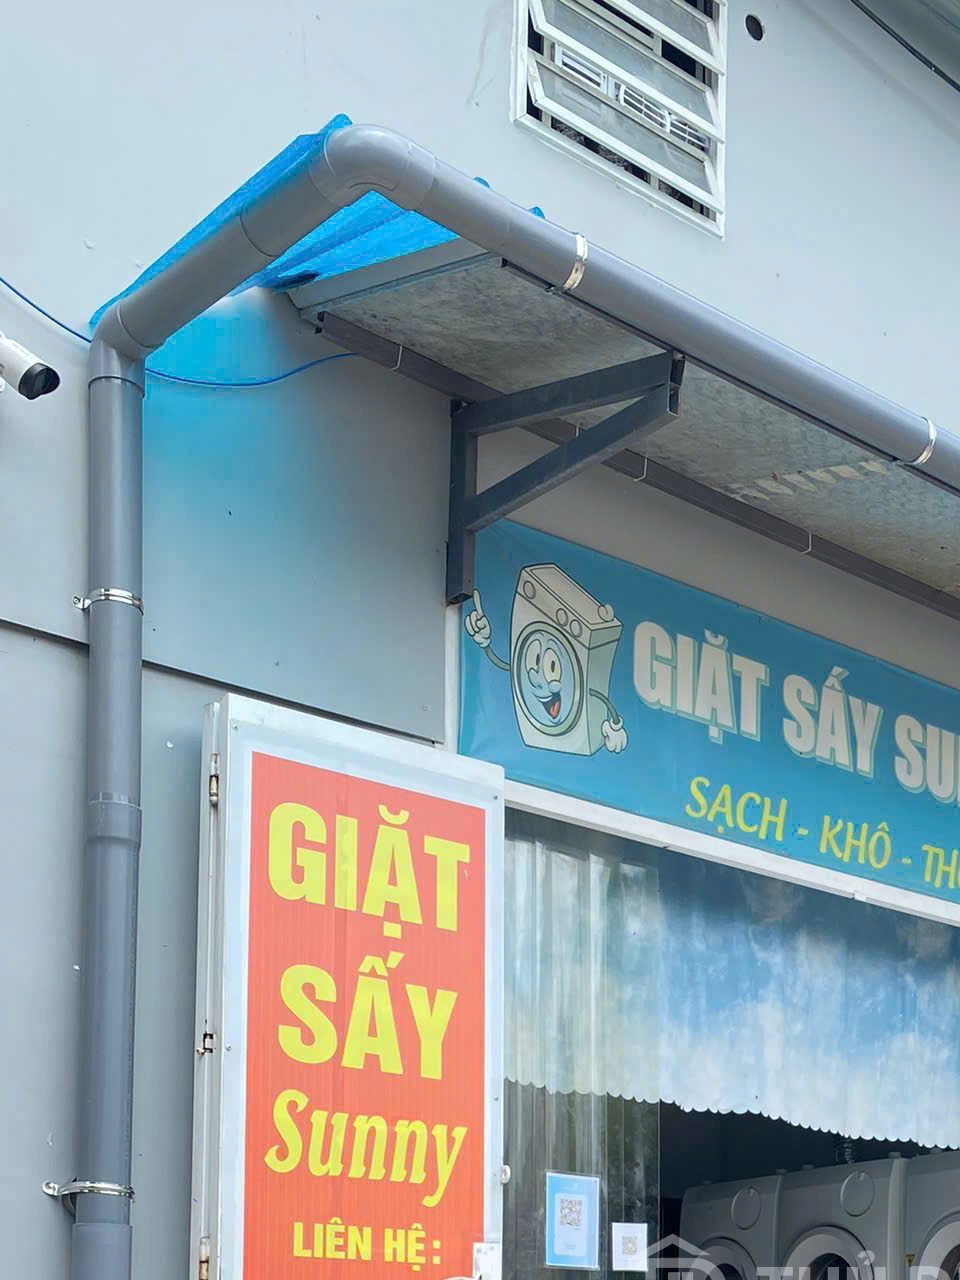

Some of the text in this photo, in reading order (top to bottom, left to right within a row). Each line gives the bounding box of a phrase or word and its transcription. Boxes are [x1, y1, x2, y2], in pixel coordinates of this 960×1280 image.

[633, 621, 769, 743] GIẶT
[783, 666, 884, 778] SẤY
[267, 801, 470, 937] GIẶT
[685, 776, 788, 841] SẠCH
[819, 815, 892, 869] KHÔ
[278, 951, 458, 1080] SẤY
[264, 1088, 468, 1207] Sunny
[293, 1217, 372, 1261] LIÊN
